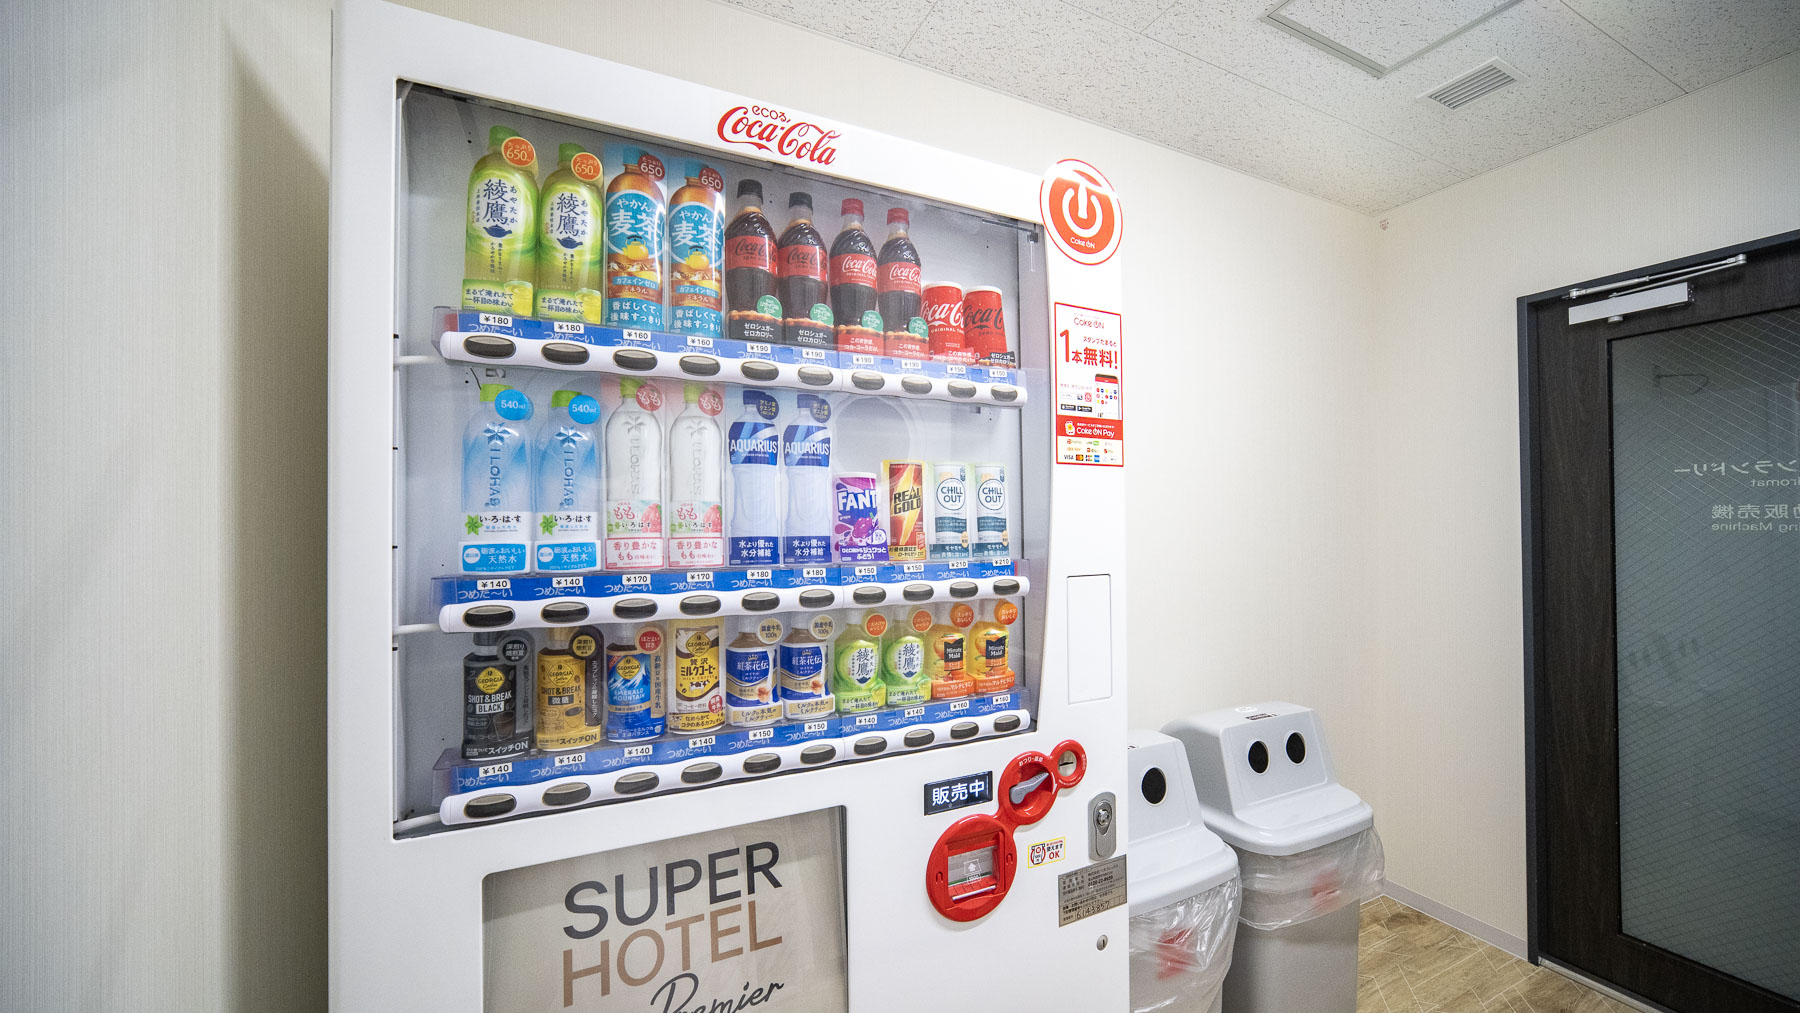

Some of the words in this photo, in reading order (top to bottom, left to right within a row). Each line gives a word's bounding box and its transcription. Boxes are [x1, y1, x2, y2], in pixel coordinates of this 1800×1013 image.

[717, 105, 842, 165] Coca-Cola
[640, 163, 662, 177] 650
[701, 175, 721, 189] 650
[483, 179, 509, 226] 綾鷹
[509, 186, 518, 224] あやたか
[616, 198, 652, 212] やかん
[557, 193, 580, 237] 綾鷹
[679, 210, 712, 223] やかん
[609, 209, 662, 241] 麦茶
[672, 220, 721, 252] 麦茶
[1070, 236, 1086, 247] Coke
[616, 277, 656, 289] カフェインゼロ
[465, 297, 514, 308] 一杯目の味わい
[484, 315, 509, 325] ¥180
[610, 312, 661, 326] 後味すっきり
[1074, 317, 1092, 328] Coke
[557, 323, 581, 332] ¥180
[673, 319, 721, 333] 後味すっきり
[744, 322, 774, 332] ゼロシュガー
[626, 331, 648, 339] ¥160
[798, 329, 827, 338] ゼロシュガー
[690, 338, 711, 346] ¥160
[749, 344, 769, 352] ¥190
[638, 391, 661, 406] もも
[699, 397, 721, 411] もも
[1076, 426, 1092, 435] Coke
[1103, 430, 1115, 438] Pay
[729, 439, 778, 454] AQUARIUS
[784, 442, 830, 455] AQUARIUS
[893, 486, 921, 504] REAL
[941, 486, 963, 495] CHILL
[982, 487, 1003, 495] CHILL
[943, 495, 962, 503] OUT
[984, 495, 1002, 503] OUT
[893, 498, 921, 515] GOLD
[613, 506, 635, 520] もも
[676, 506, 697, 520] もも
[613, 541, 656, 551] 香り豊かな
[676, 541, 718, 550] 香り豊かな
[738, 539, 774, 548] 水より優れた
[792, 538, 826, 547] 水より優れた
[560, 553, 589, 563] 天然水
[740, 548, 773, 557] 水分補給
[794, 548, 824, 557] 水分補給
[488, 554, 517, 564] 天然水
[690, 573, 711, 581] ¥170
[805, 569, 824, 577] ¥180
[481, 580, 508, 589] ¥140
[555, 578, 580, 586] ¥140
[791, 655, 822, 666] 紅茶花伝
[856, 647, 870, 677] 綾鷹
[902, 643, 916, 671] 綾鷹
[680, 664, 716, 677] ミルクコーヒー
[736, 660, 769, 671] 紅茶花伝
[477, 675, 504, 684] GEORGIA
[549, 670, 573, 679] GEORGIA
[541, 686, 555, 696] SHOT
[555, 687, 562, 695] &
[562, 685, 582, 695] BREAK
[614, 687, 644, 697] EMERALD
[467, 694, 484, 704] SHOT
[484, 694, 491, 704] &
[491, 690, 512, 703] BREAK
[551, 696, 570, 705] 微糖
[612, 693, 645, 702] MOUNTAIN
[478, 703, 502, 713] BLACK
[692, 738, 713, 746] ¥140
[627, 747, 650, 756] ¥140
[558, 755, 583, 764] ¥140
[482, 765, 509, 776] ¥140
[932, 780, 985, 806] 販売中
[1048, 850, 1060, 860] OK
[563, 841, 782, 940] SUPER
[563, 900, 783, 1008] HOTEL
